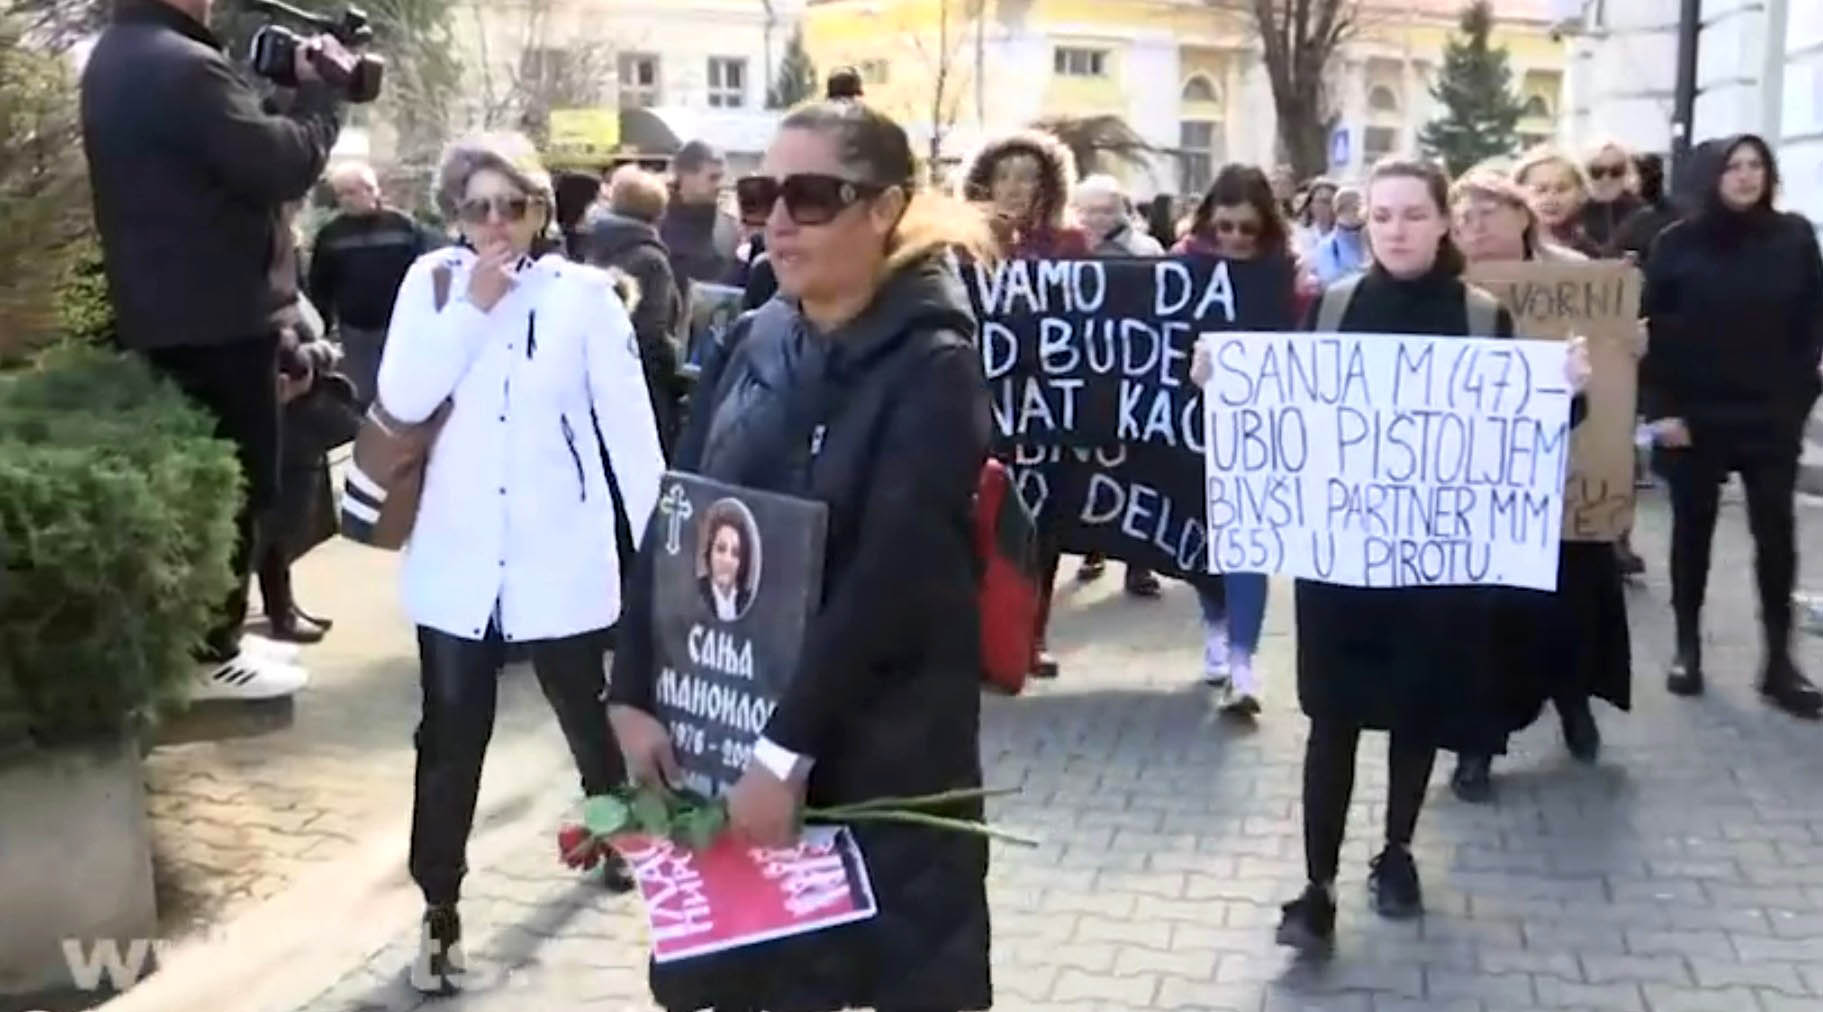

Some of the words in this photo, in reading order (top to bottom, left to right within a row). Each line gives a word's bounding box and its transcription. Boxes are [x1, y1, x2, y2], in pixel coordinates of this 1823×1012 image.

[1154, 260, 1236, 322] DA
[1040, 317, 1190, 387] BUDE
[1218, 339, 1370, 407] SANJA
[1393, 341, 1434, 407] M
[1211, 407, 1307, 473] UBIO
[1081, 473, 1206, 571] DELO
[1209, 475, 1304, 529] BIVŠI
[1328, 477, 1476, 538] PARTNER
[1490, 489, 1549, 547] MM
[1213, 528, 1285, 573] (55)
[1312, 530, 1335, 578] U
[687, 623, 754, 680] САЊА
